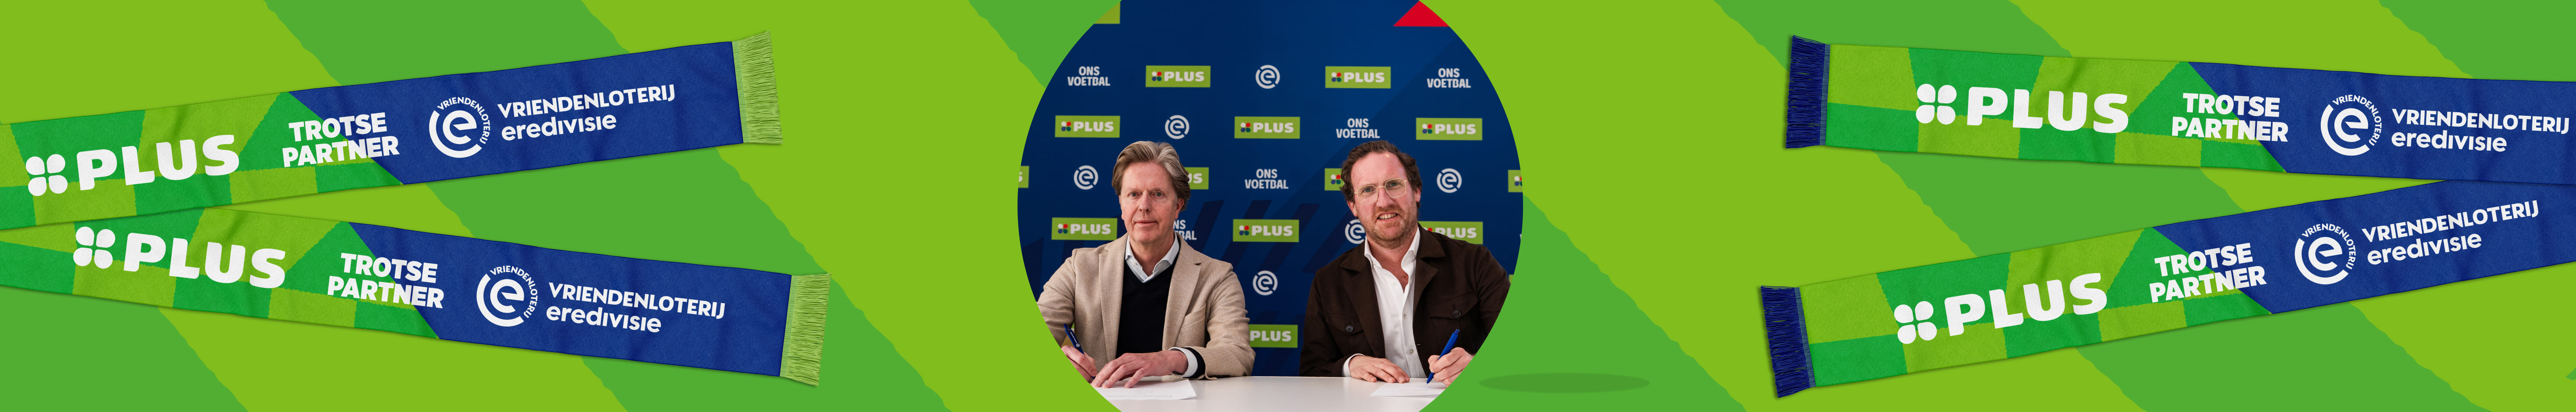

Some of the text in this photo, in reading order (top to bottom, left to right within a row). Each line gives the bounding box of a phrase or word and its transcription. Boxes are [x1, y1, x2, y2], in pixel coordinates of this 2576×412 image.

[1067, 76, 1110, 86] VOETBAL
[1079, 66, 1100, 76] ONS
[1164, 71, 1205, 82] PLUS
[1344, 72, 1385, 83] PLUS
[1427, 78, 1471, 88] VOETBAL
[1438, 68, 1460, 78] ONS
[497, 84, 675, 118] VRIENDENLOTERIJ
[1967, 87, 2128, 133] PLUS
[2183, 93, 2280, 117] TROTSE
[289, 112, 387, 142] TROTSE
[437, 97, 490, 144] VRIENDENLOTERIJ
[502, 115, 616, 140] eredivisie
[1073, 121, 1114, 132] PLUS
[1253, 122, 1294, 133] PLUS
[1336, 128, 1380, 138] VOETBAL
[1347, 118, 1369, 128] ONS
[1435, 124, 1476, 135] PLUS
[2172, 117, 2288, 142] PARTNER
[2332, 95, 2382, 146] VRIENDENLOTERIJ
[2392, 109, 2569, 134] VRIENDENLOTERIJ
[283, 136, 399, 167] PARTNER
[2392, 130, 2506, 152] eredivisie
[77, 135, 239, 190] PLUS
[1256, 169, 1278, 179] ONS
[1245, 179, 1288, 189] VOETBAL
[1070, 224, 1111, 235] PLUS
[1173, 220, 1186, 229] NS
[1252, 225, 1293, 236] PLUS
[1435, 227, 1477, 239] PLUS
[2362, 200, 2538, 242] VRIENDENLOTERIJ
[2154, 243, 2253, 276] TROTSE
[2302, 224, 2356, 270] VRIENDENLOTERIJ
[2368, 233, 2481, 264] eredivisie
[124, 233, 285, 288] PLUS
[341, 253, 438, 283] TROTSE
[328, 276, 444, 308] PARTNER
[490, 266, 538, 316] VRIENDENLOTERIJ
[2149, 266, 2267, 303] PARTNER
[549, 282, 725, 319] VRIENDENLOTERIJ
[1944, 273, 2107, 336] PLUS
[547, 306, 661, 332] eredivisie
[1250, 330, 1292, 342] PLUS
